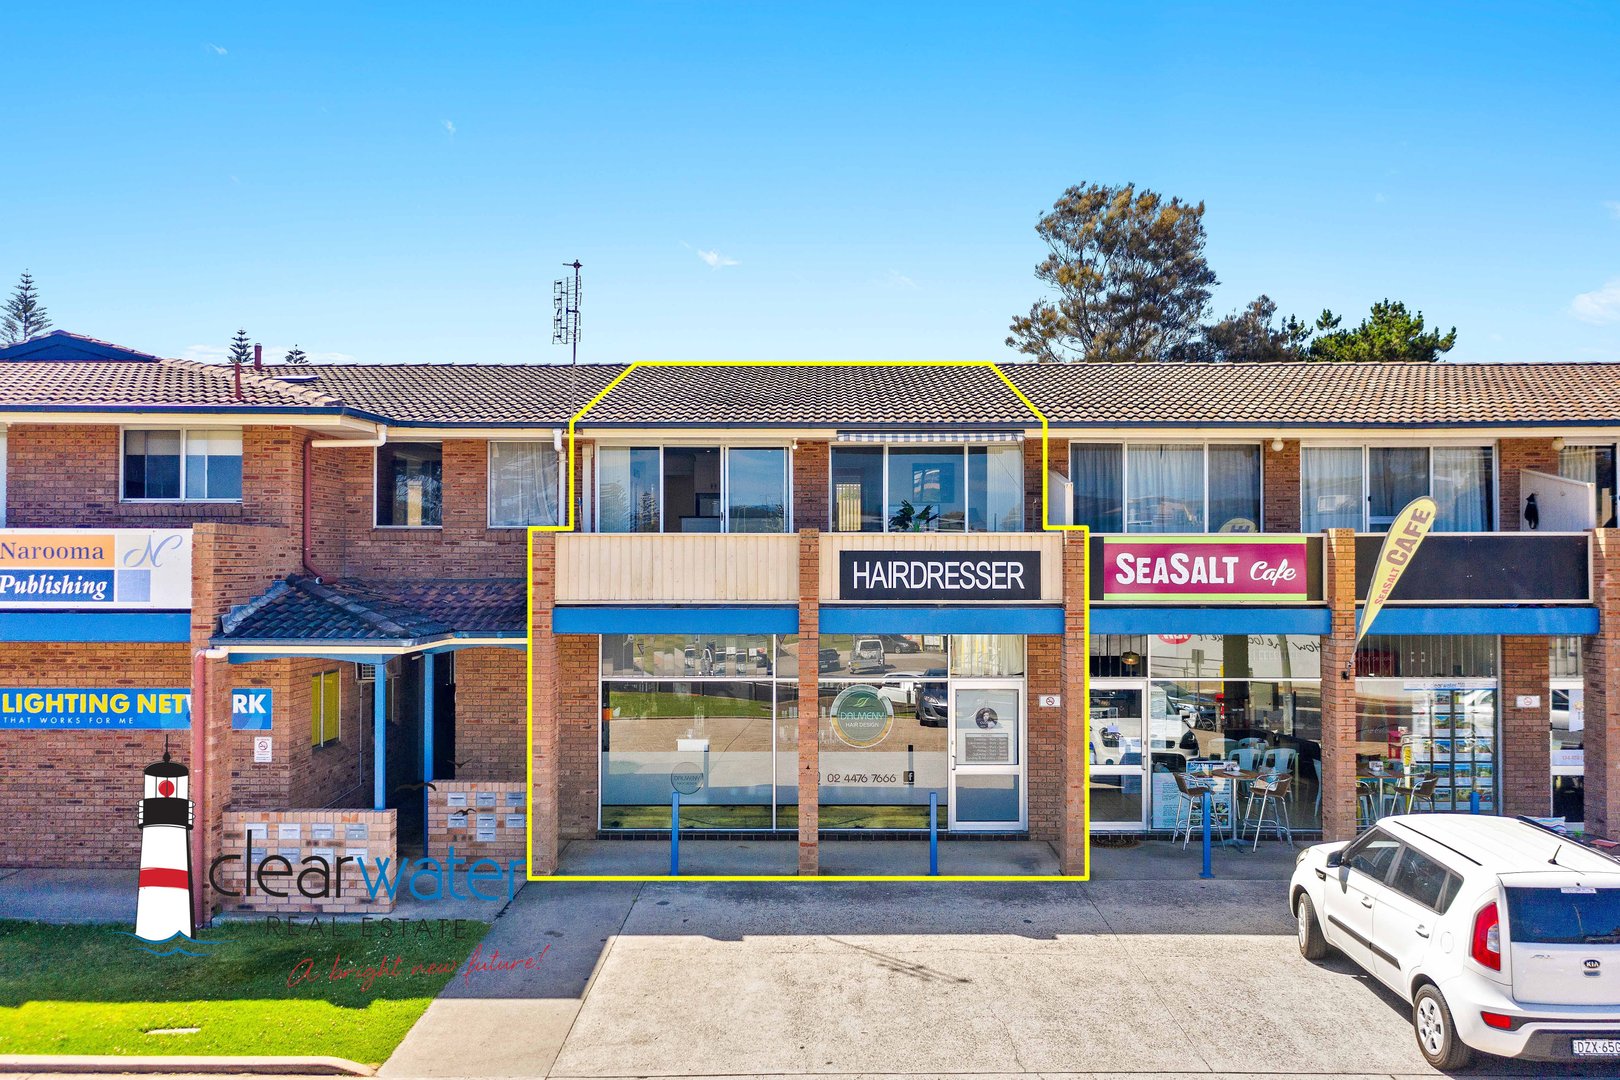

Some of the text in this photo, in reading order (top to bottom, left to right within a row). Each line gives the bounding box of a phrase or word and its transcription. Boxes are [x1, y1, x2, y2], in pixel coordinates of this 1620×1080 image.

[1386, 508, 1431, 566] CAFE
[0, 542, 105, 560] Narooma
[853, 560, 1025, 590] HAIRDRESSER
[1250, 558, 1297, 587] Cafe
[0, 574, 108, 600] Publishing
[2, 693, 130, 714] LIGHTING
[3, 716, 134, 724] THAT WORKS FOR ME
[840, 711, 885, 720] DALMENY
[827, 773, 897, 783] 02 4476 7666
